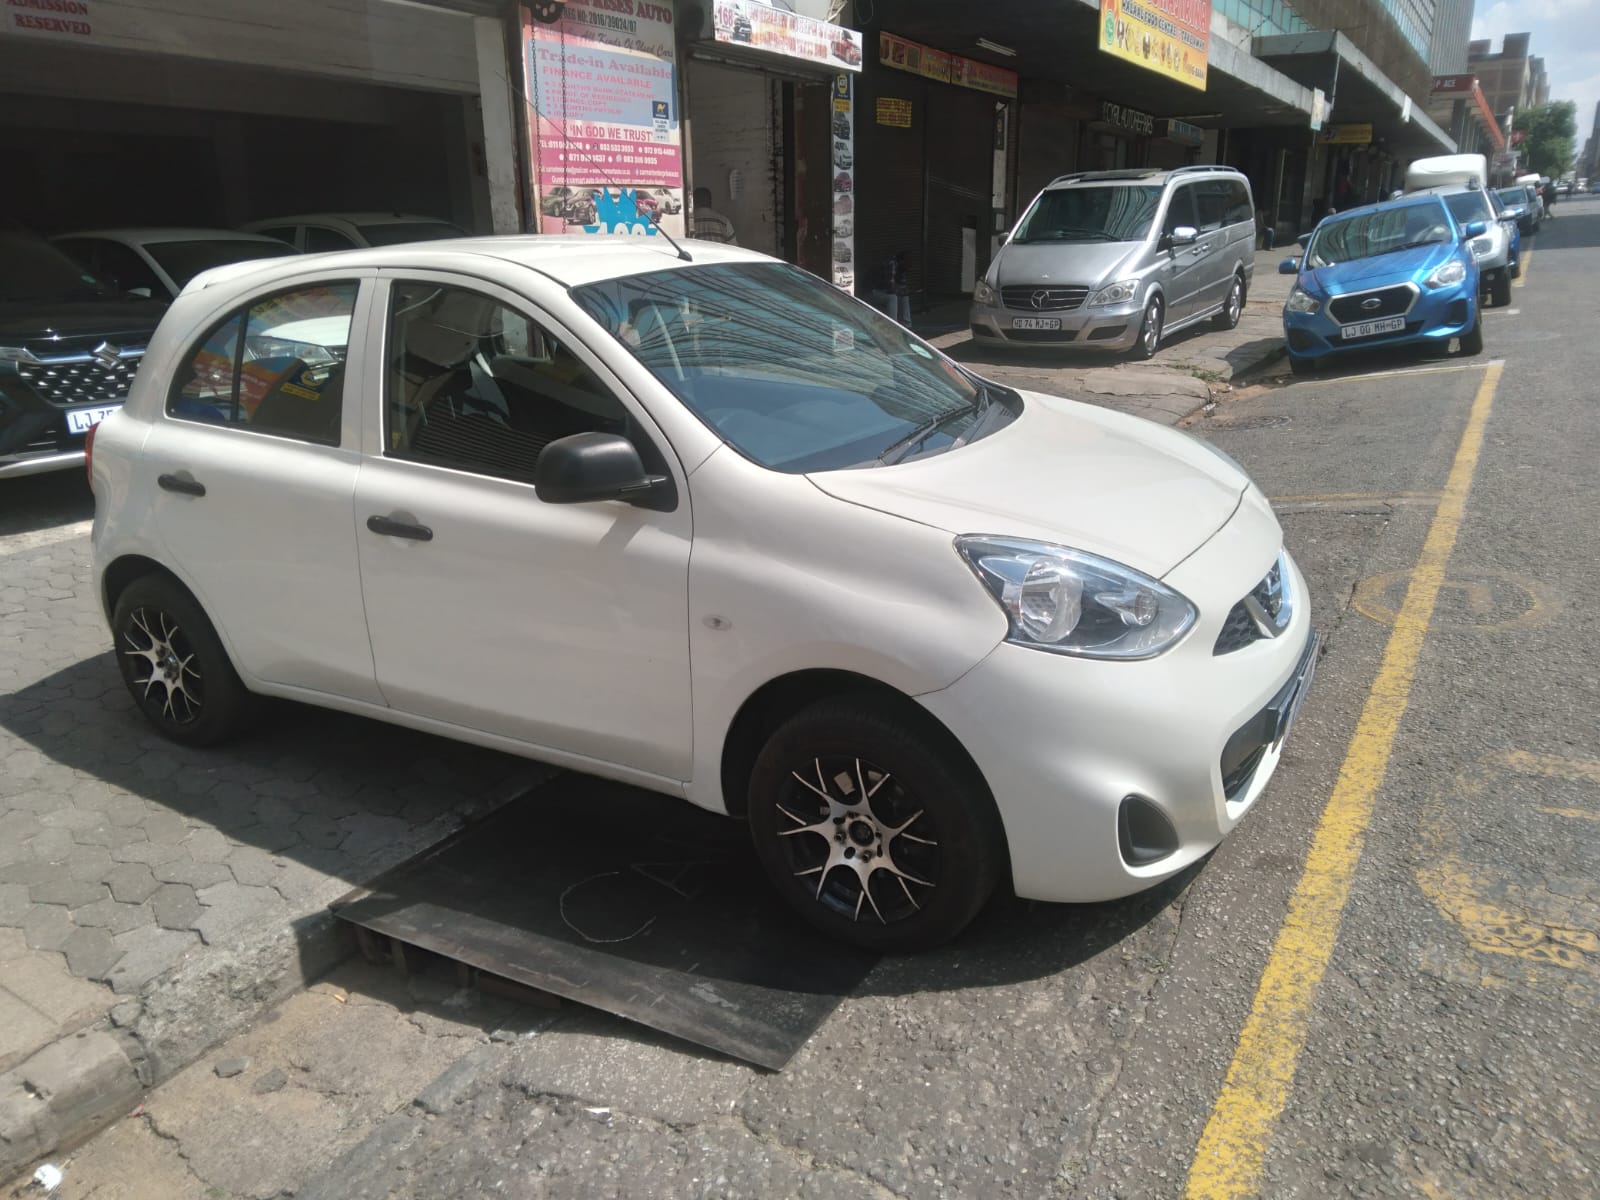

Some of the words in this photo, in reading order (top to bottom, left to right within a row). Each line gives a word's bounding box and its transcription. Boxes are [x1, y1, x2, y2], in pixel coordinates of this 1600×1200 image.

[636, 2, 673, 24] AUTO
[718, 6, 733, 26] 168
[15, 14, 91, 35] RESERVED
[598, 33, 621, 47] Kinds
[537, 48, 605, 69] Trade-in
[608, 58, 673, 79] Available
[543, 66, 592, 80] FINANCE
[596, 73, 652, 88] AVAILABLE
[585, 126, 605, 138] GOD
[607, 128, 621, 139] WE
[1024, 319, 1033, 328] 74
[1049, 320, 1059, 329] GP
[1344, 327, 1356, 338] LJ
[1391, 319, 1402, 329] GP
[73, 412, 93, 430] LJ
